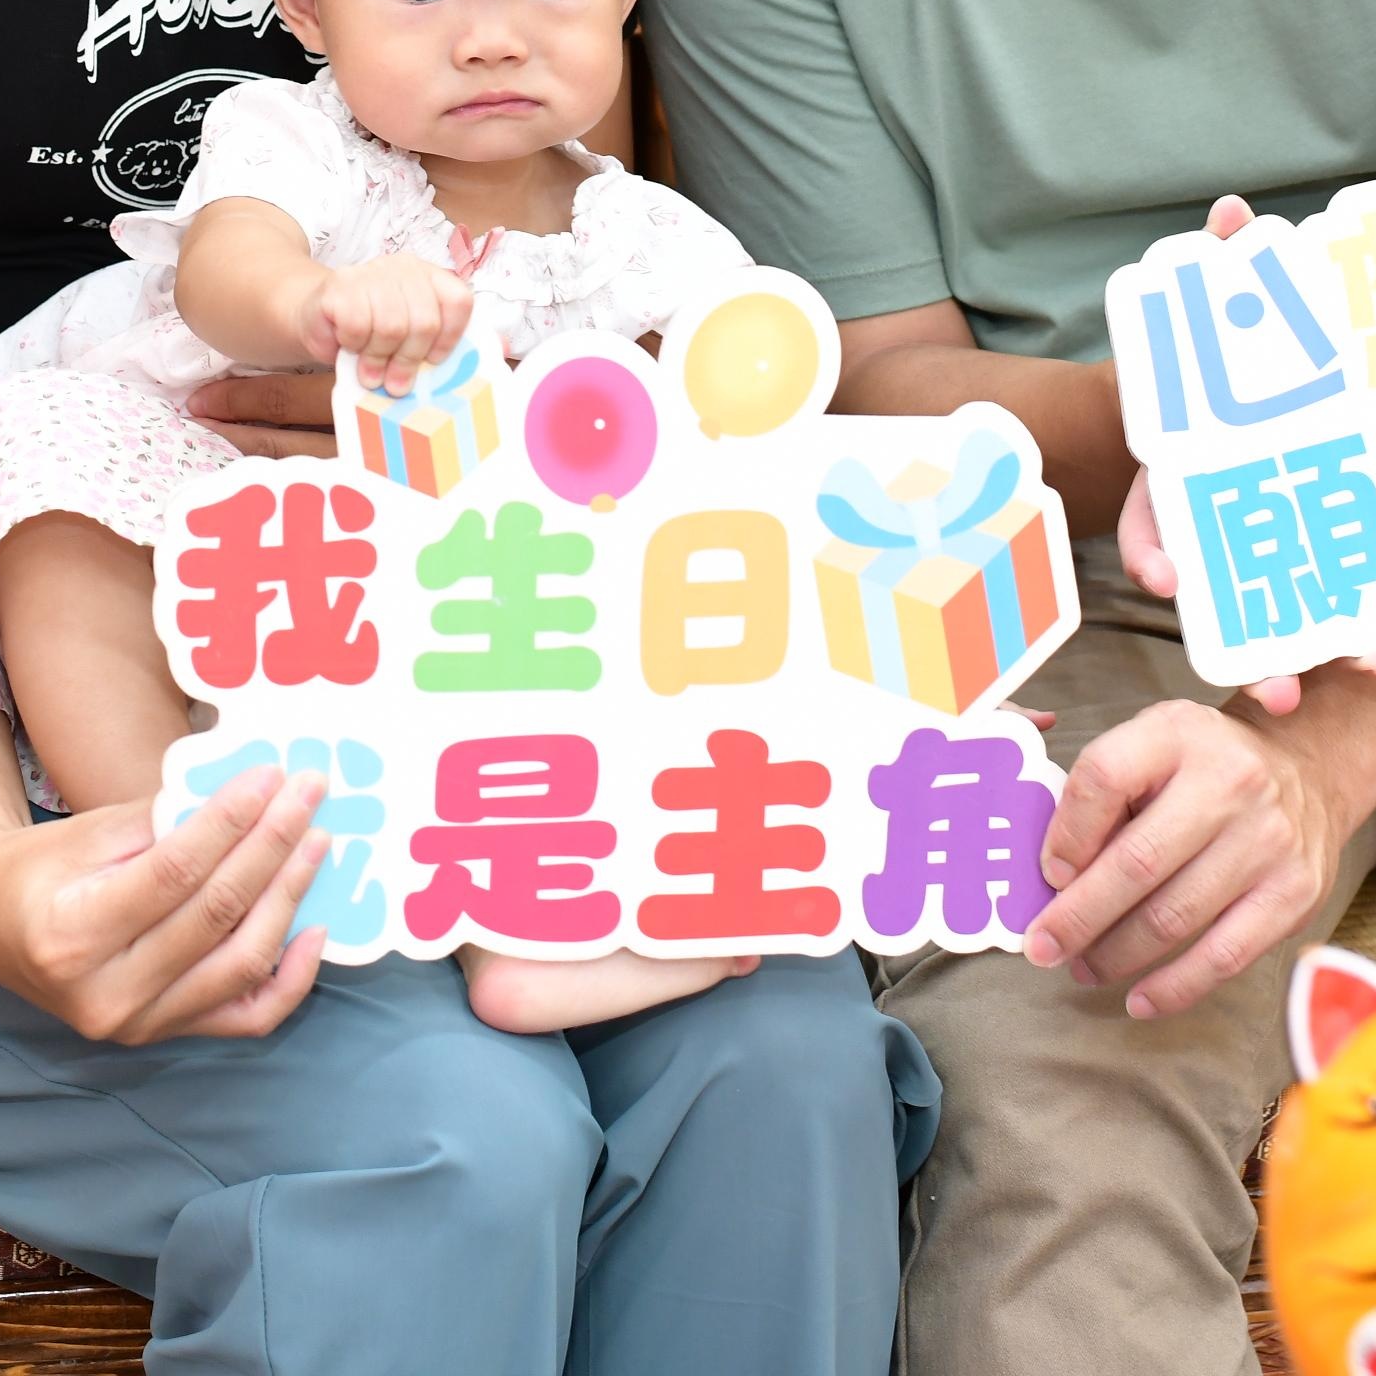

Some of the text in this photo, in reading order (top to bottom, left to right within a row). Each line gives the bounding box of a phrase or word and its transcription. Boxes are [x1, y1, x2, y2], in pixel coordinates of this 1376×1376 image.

[26, 146, 84, 165] Est.
[176, 482, 790, 696] 我生日
